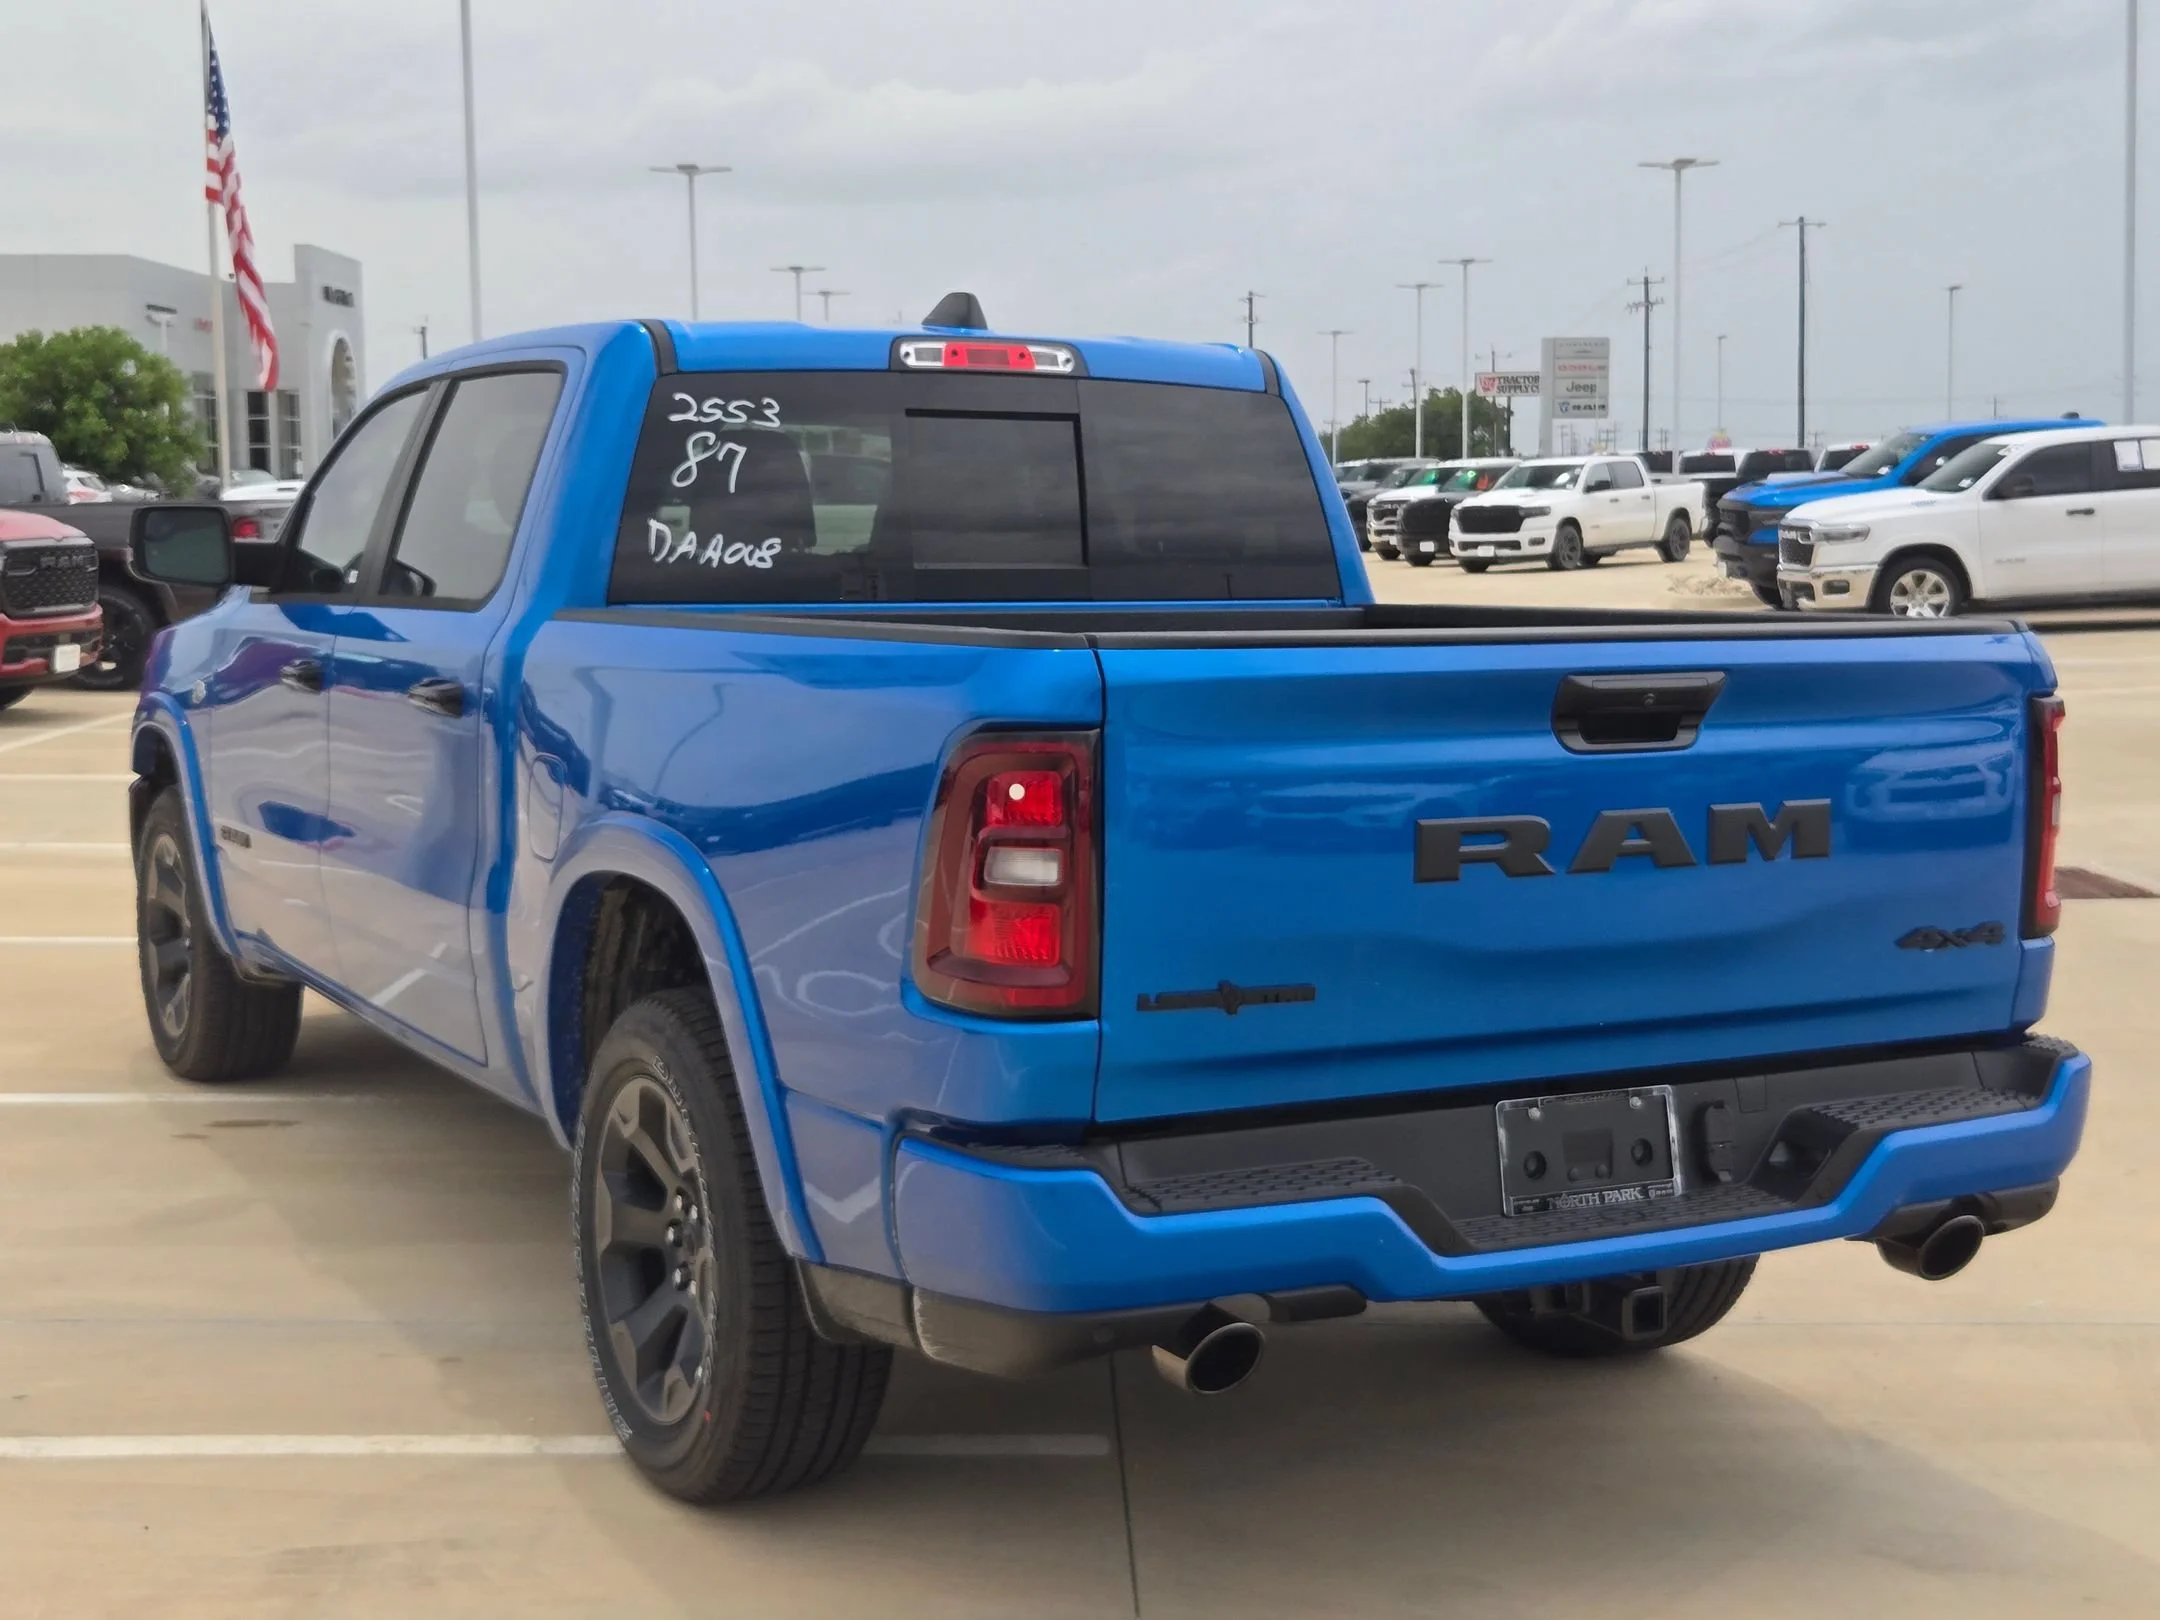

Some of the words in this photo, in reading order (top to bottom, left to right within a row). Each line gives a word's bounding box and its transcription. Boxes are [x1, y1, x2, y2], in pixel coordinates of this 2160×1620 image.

[1496, 384, 1529, 394] SUPPLY
[1566, 380, 1597, 395] Jeep
[667, 392, 782, 428] 2553
[671, 431, 748, 494] 87
[1413, 798, 1832, 884] RAM
[1602, 1186, 1643, 1203] PARK
